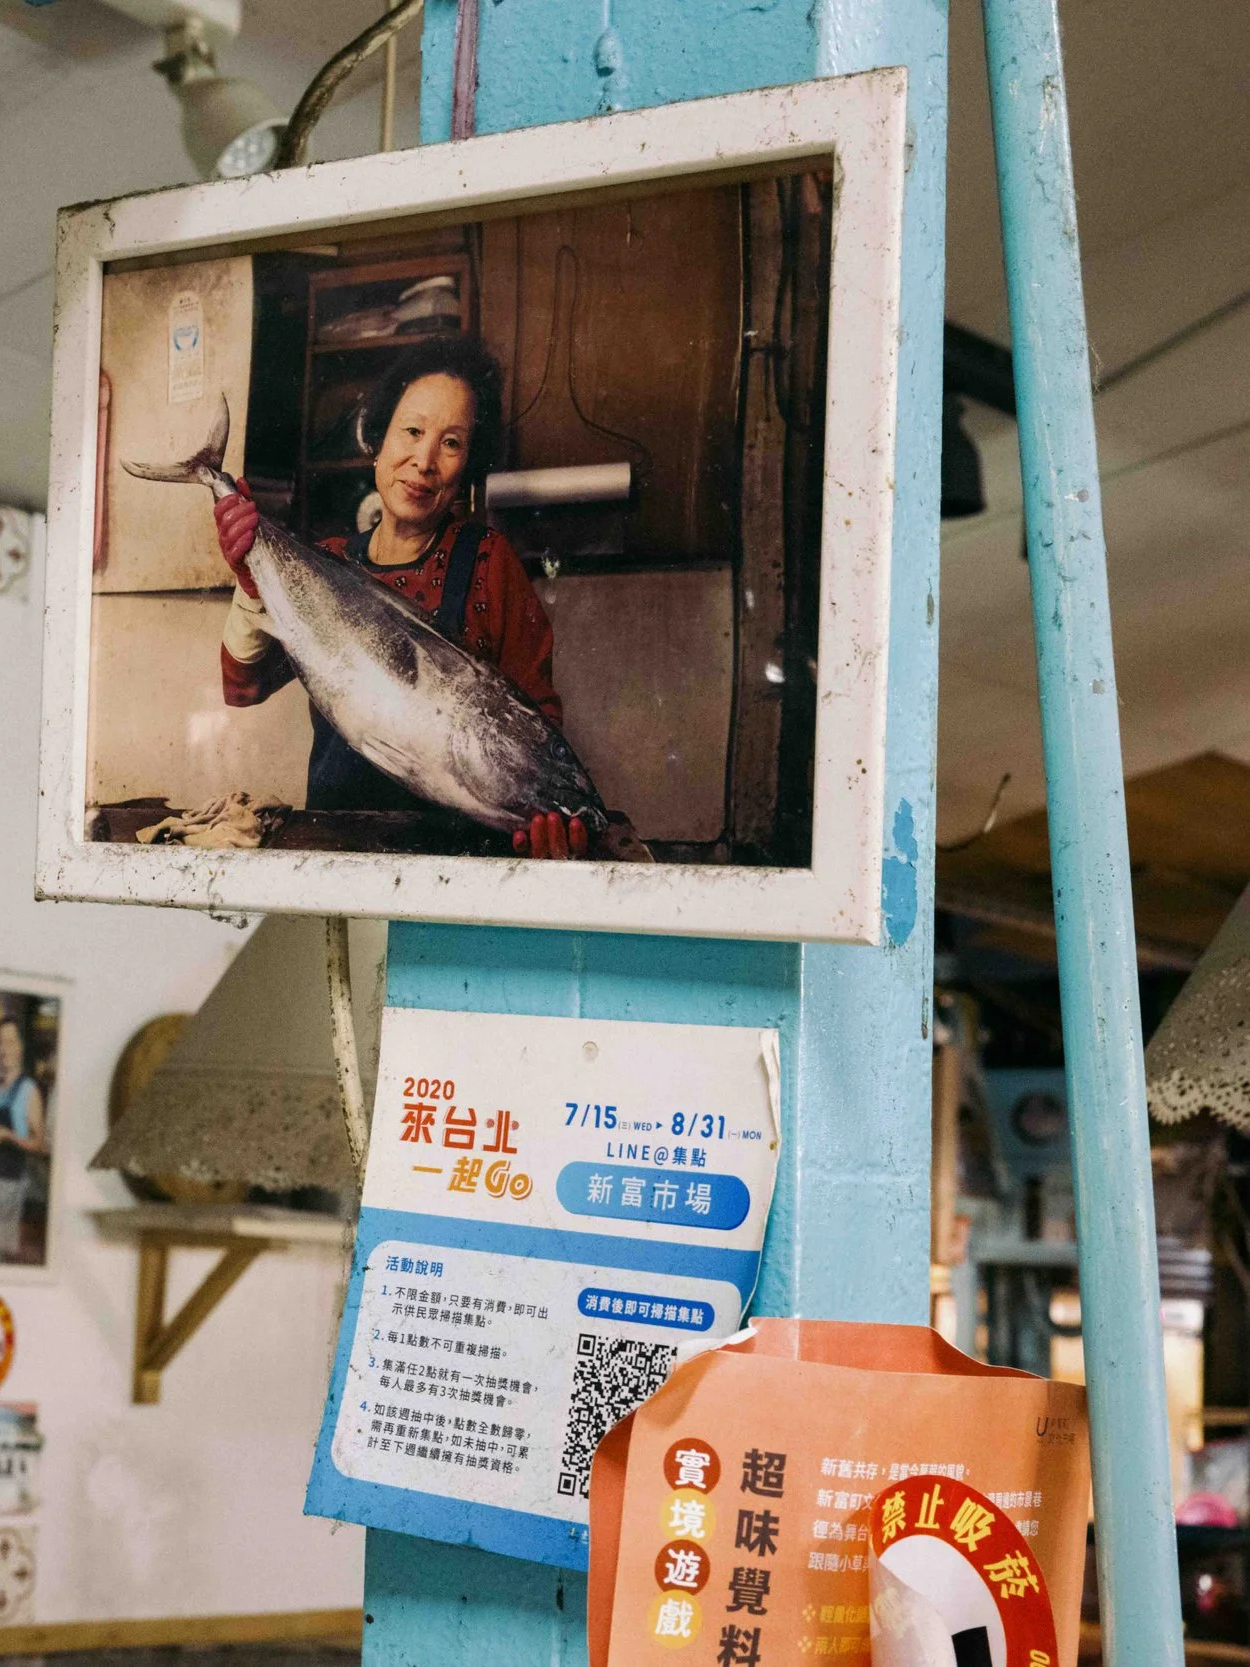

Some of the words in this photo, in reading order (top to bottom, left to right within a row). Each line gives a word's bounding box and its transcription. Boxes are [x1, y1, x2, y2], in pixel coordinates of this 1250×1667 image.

[403, 1077, 455, 1100] 2020
[399, 1102, 520, 1155] 來台北
[565, 1102, 617, 1129] 7/15
[634, 1121, 652, 1131] WED
[671, 1112, 726, 1140] 8/31
[742, 1129, 762, 1140] MON
[606, 1141, 707, 1167] LINE@集點
[411, 1155, 533, 1201] 一起Go
[587, 1173, 712, 1215] 新富市場
[385, 1255, 444, 1277] 活動說明
[381, 1285, 392, 1297] 1.
[585, 1294, 704, 1326] 消費後即可掃描集點
[373, 1330, 384, 1341] 2.
[368, 1357, 379, 1368] 3.
[360, 1401, 371, 1412] 4.
[654, 1448, 712, 1639] 實境遊戲
[715, 1448, 787, 1667] 超味覺料
[881, 1483, 1040, 1600] 禁止吸菸
